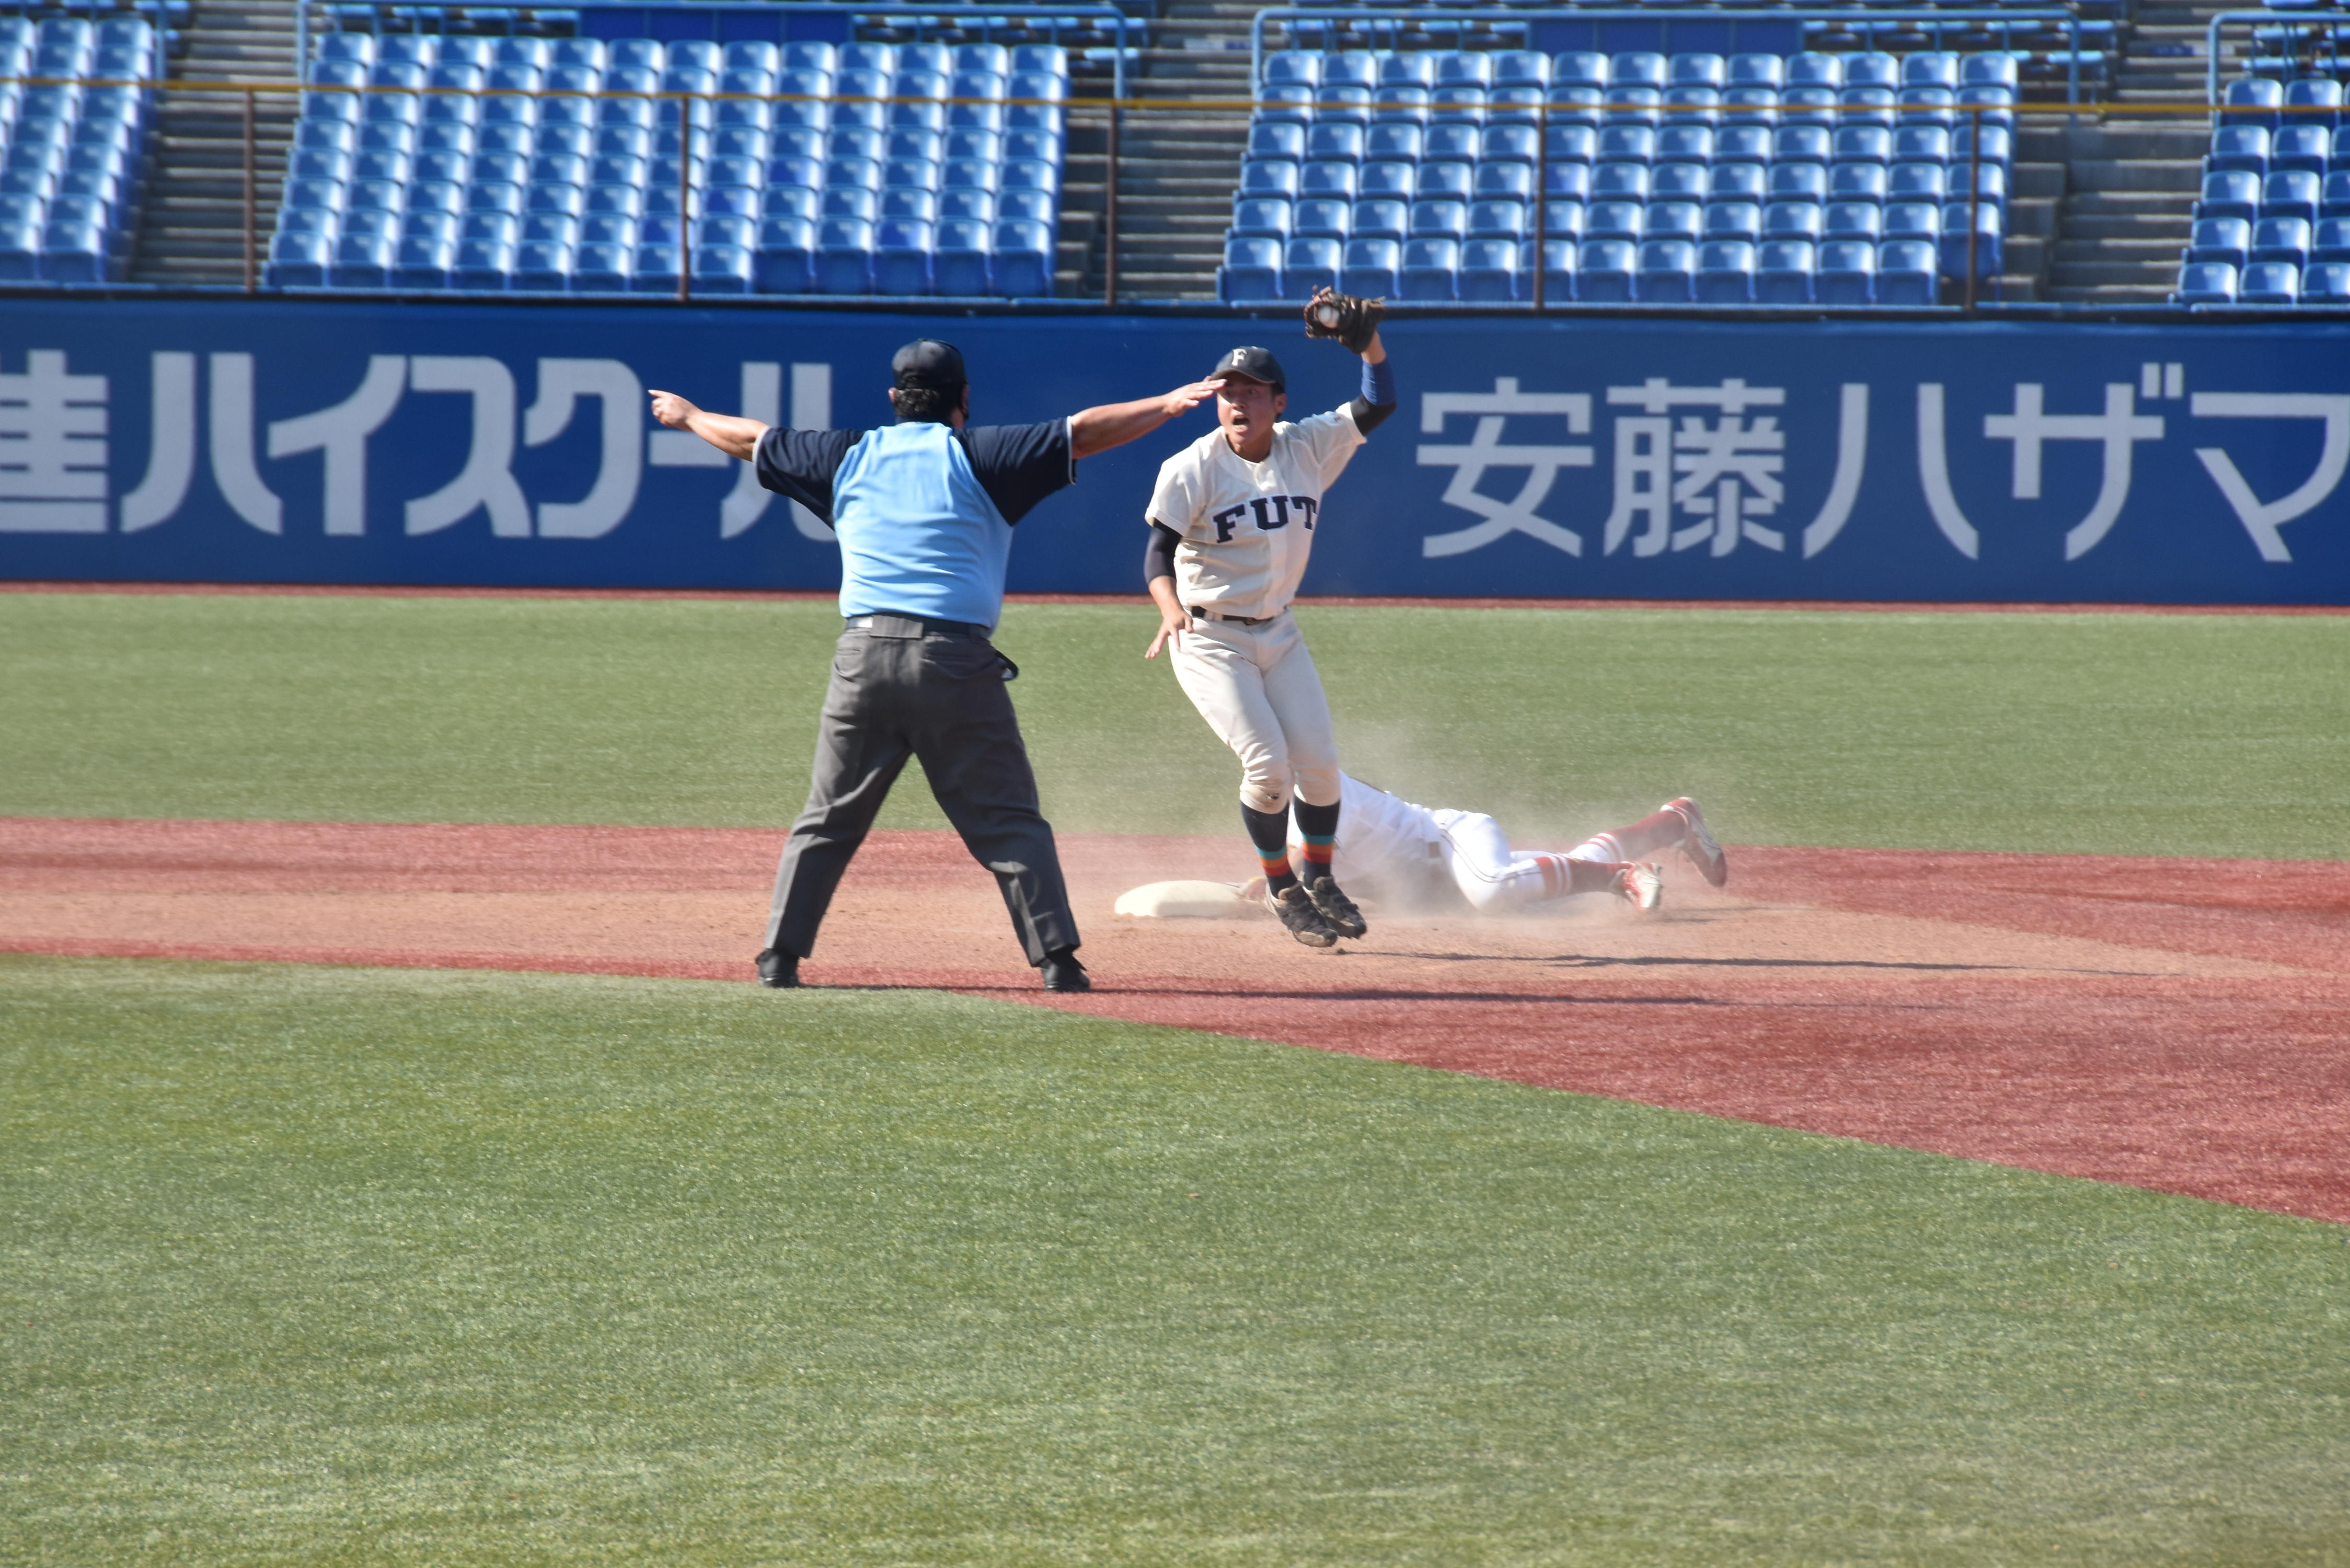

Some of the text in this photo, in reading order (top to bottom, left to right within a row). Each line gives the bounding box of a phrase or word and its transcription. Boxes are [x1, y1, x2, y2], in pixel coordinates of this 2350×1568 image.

[1231, 348, 1247, 366] F
[1416, 363, 2350, 562] 安藤ハザマ
